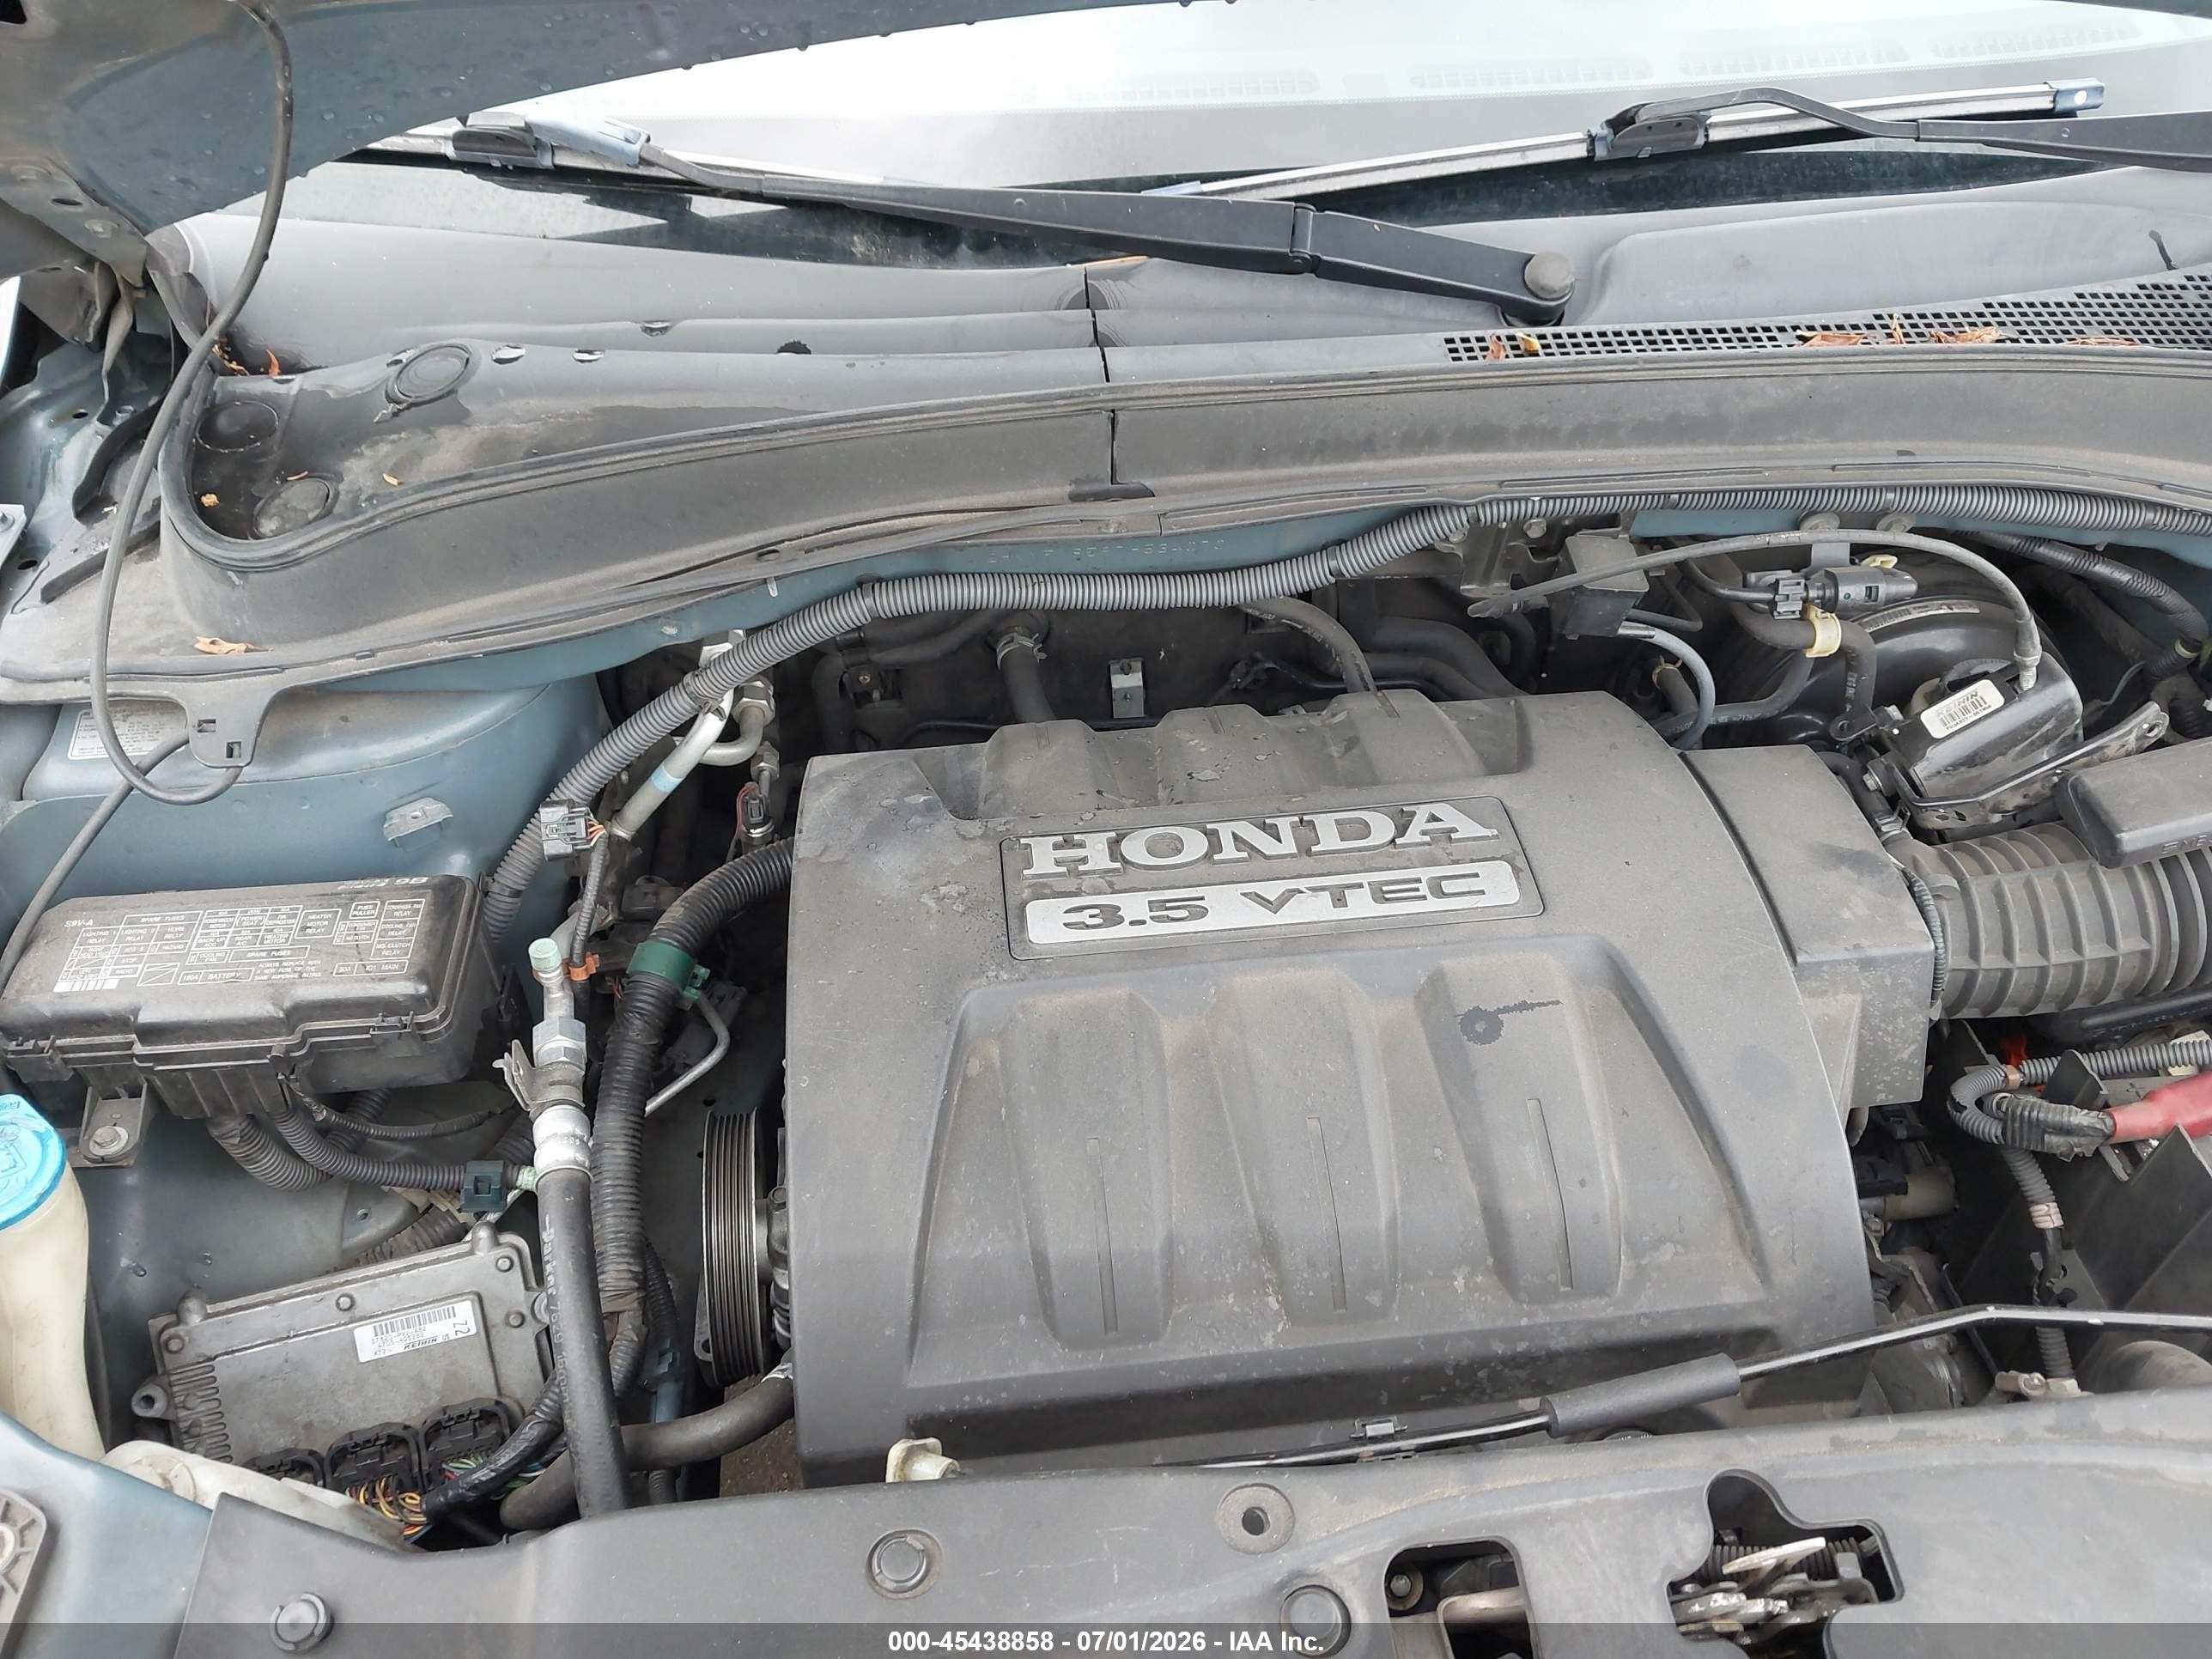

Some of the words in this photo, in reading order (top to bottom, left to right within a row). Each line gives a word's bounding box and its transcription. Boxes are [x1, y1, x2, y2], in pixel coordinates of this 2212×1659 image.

[1020, 802, 1500, 880] HONDA
[1061, 896, 1209, 932] 3.5
[1239, 872, 1486, 916] VTEC
[64, 918, 94, 927] S9V-A
[404, 1337, 438, 1351] KEIHIN
